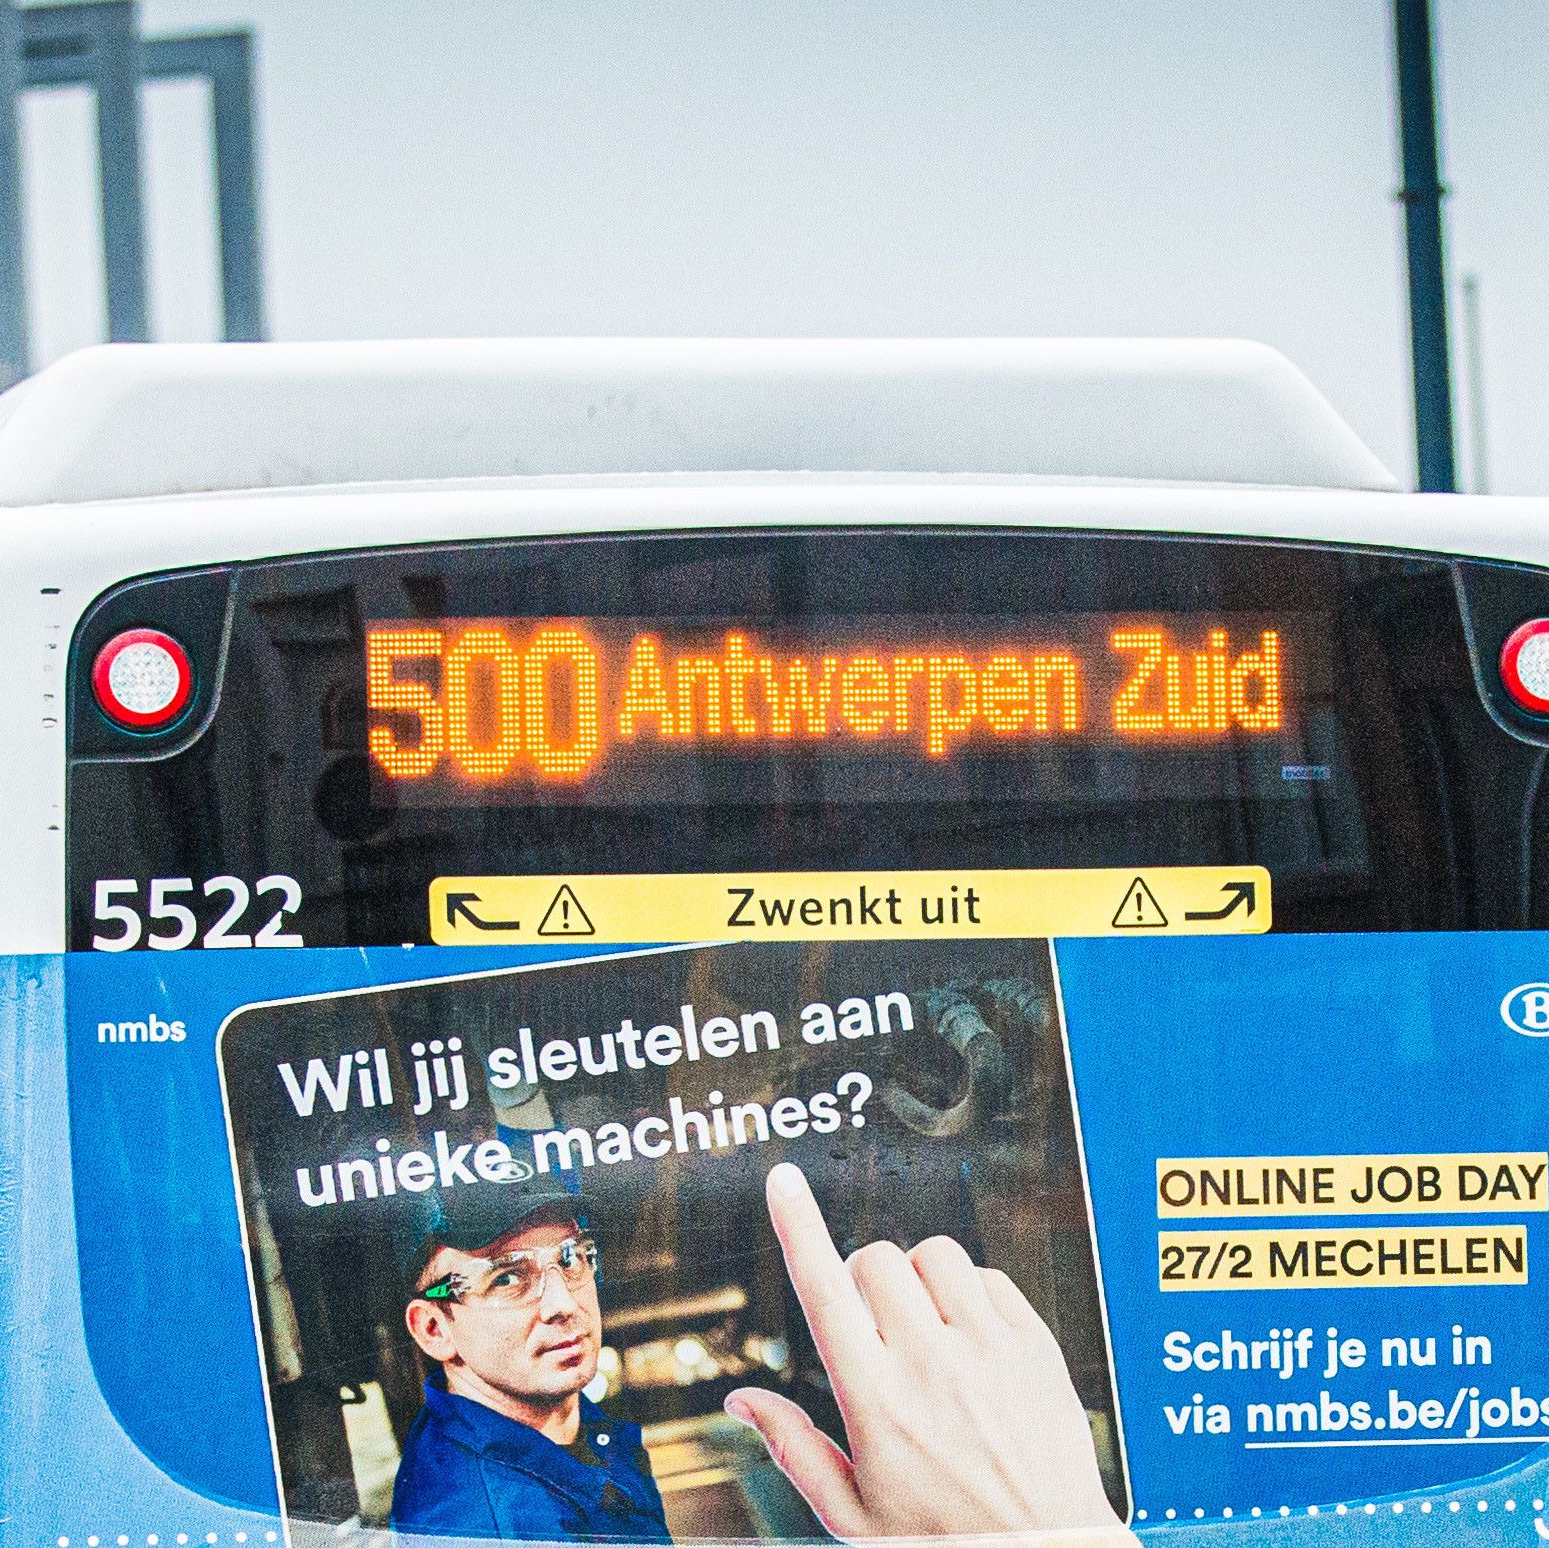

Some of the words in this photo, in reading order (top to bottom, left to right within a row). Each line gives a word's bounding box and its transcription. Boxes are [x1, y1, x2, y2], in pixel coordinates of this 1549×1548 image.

[368, 630, 599, 775] 500
[619, 635, 1078, 755] Antwerpen
[1112, 630, 1280, 731] Zuid
[93, 875, 303, 952] 5522
[727, 886, 904, 928] Zwenkt
[920, 886, 981, 926] uit
[98, 1017, 187, 1044] nmbs
[278, 1048, 394, 1118] Wil
[410, 1036, 470, 1117] jij
[488, 1005, 781, 1090] sleutelen
[800, 991, 914, 1044] aan
[296, 1128, 513, 1208] unieke
[533, 1070, 875, 1174] machines?
[1159, 1167, 1335, 1208] ONLINE
[1350, 1164, 1442, 1204] JOB
[1458, 1162, 1547, 1202] DAY
[1160, 1243, 1254, 1282] 27/2
[1270, 1236, 1524, 1278] MECHELEN
[1162, 1327, 1314, 1379] Schrijf
[1325, 1328, 1366, 1378] je
[1382, 1334, 1437, 1367] nu
[1452, 1326, 1491, 1366] in
[1164, 1395, 1230, 1435] via
